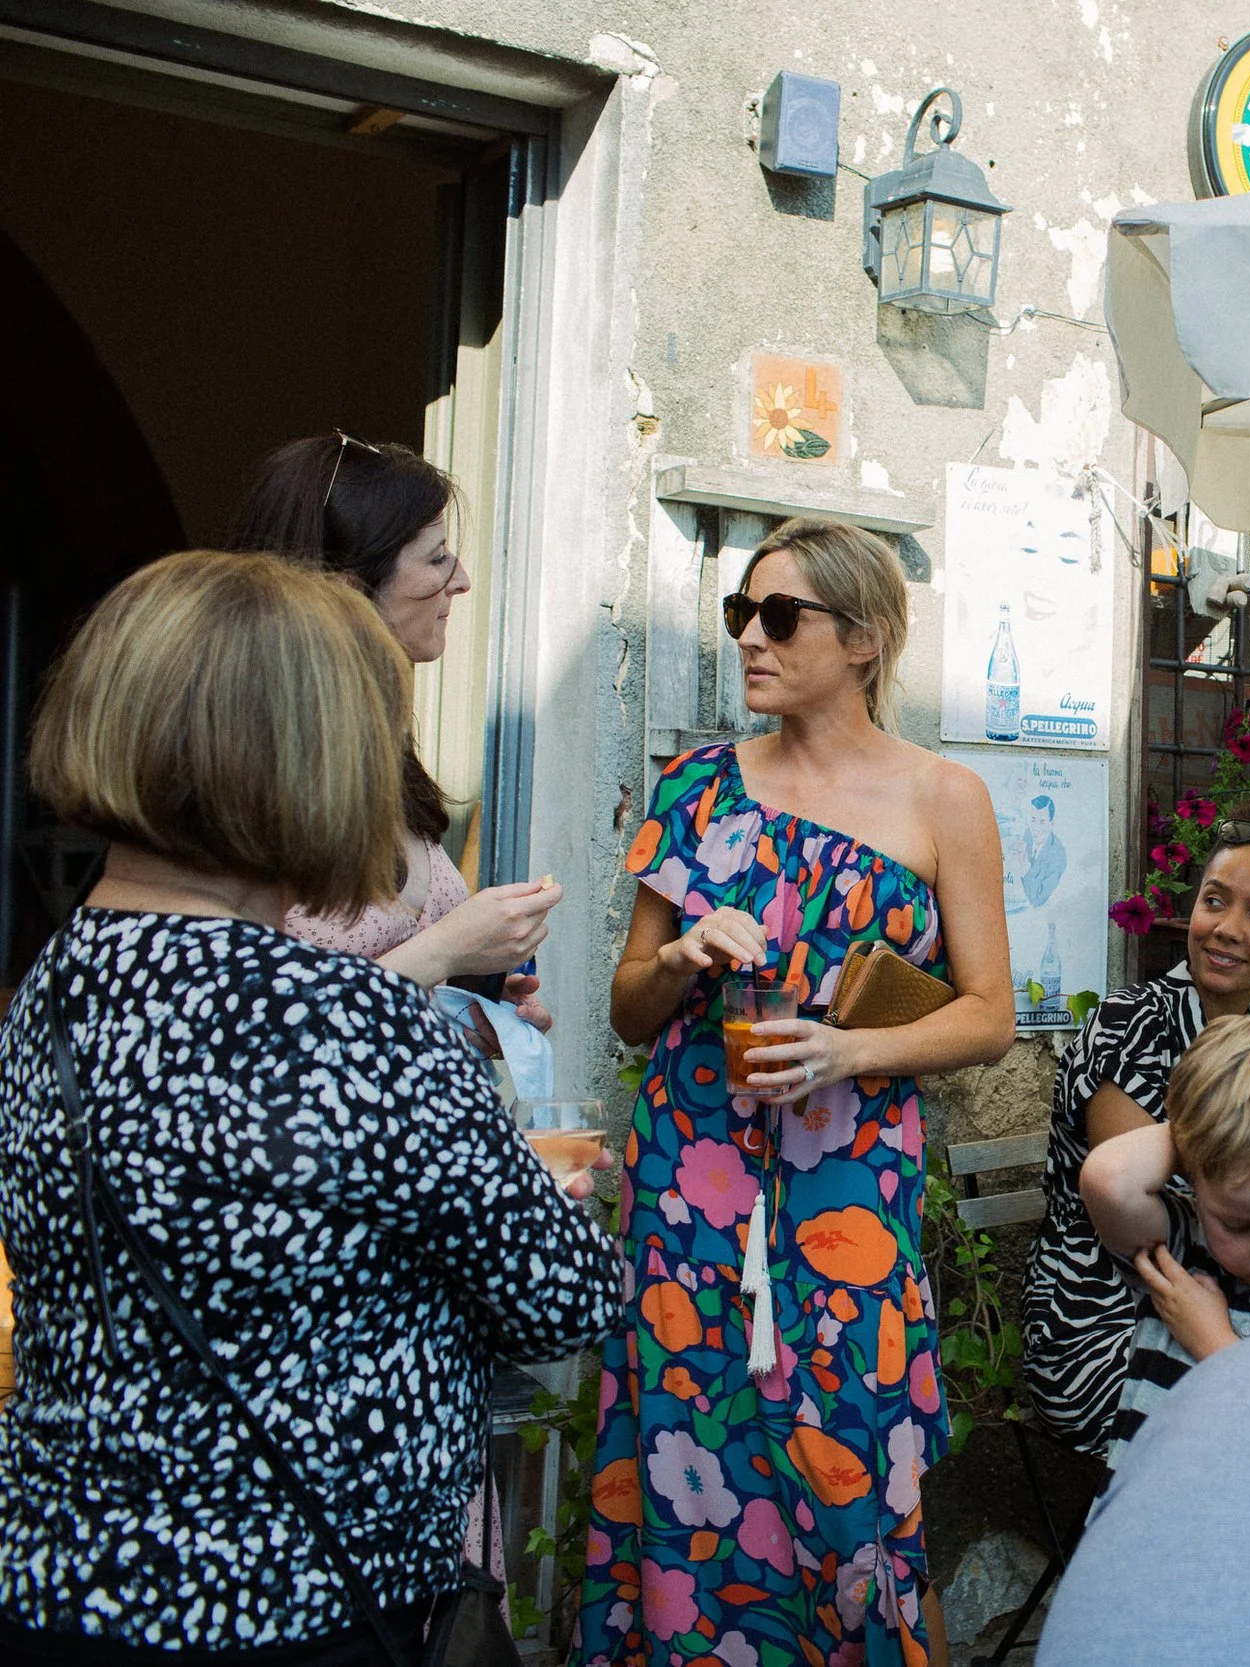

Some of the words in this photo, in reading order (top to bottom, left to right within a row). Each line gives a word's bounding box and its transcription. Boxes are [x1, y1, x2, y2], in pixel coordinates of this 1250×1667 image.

[804, 367, 837, 420] 4
[1059, 692, 1096, 715] Acqua
[1021, 719, 1097, 736] S.PELLEGRINO
